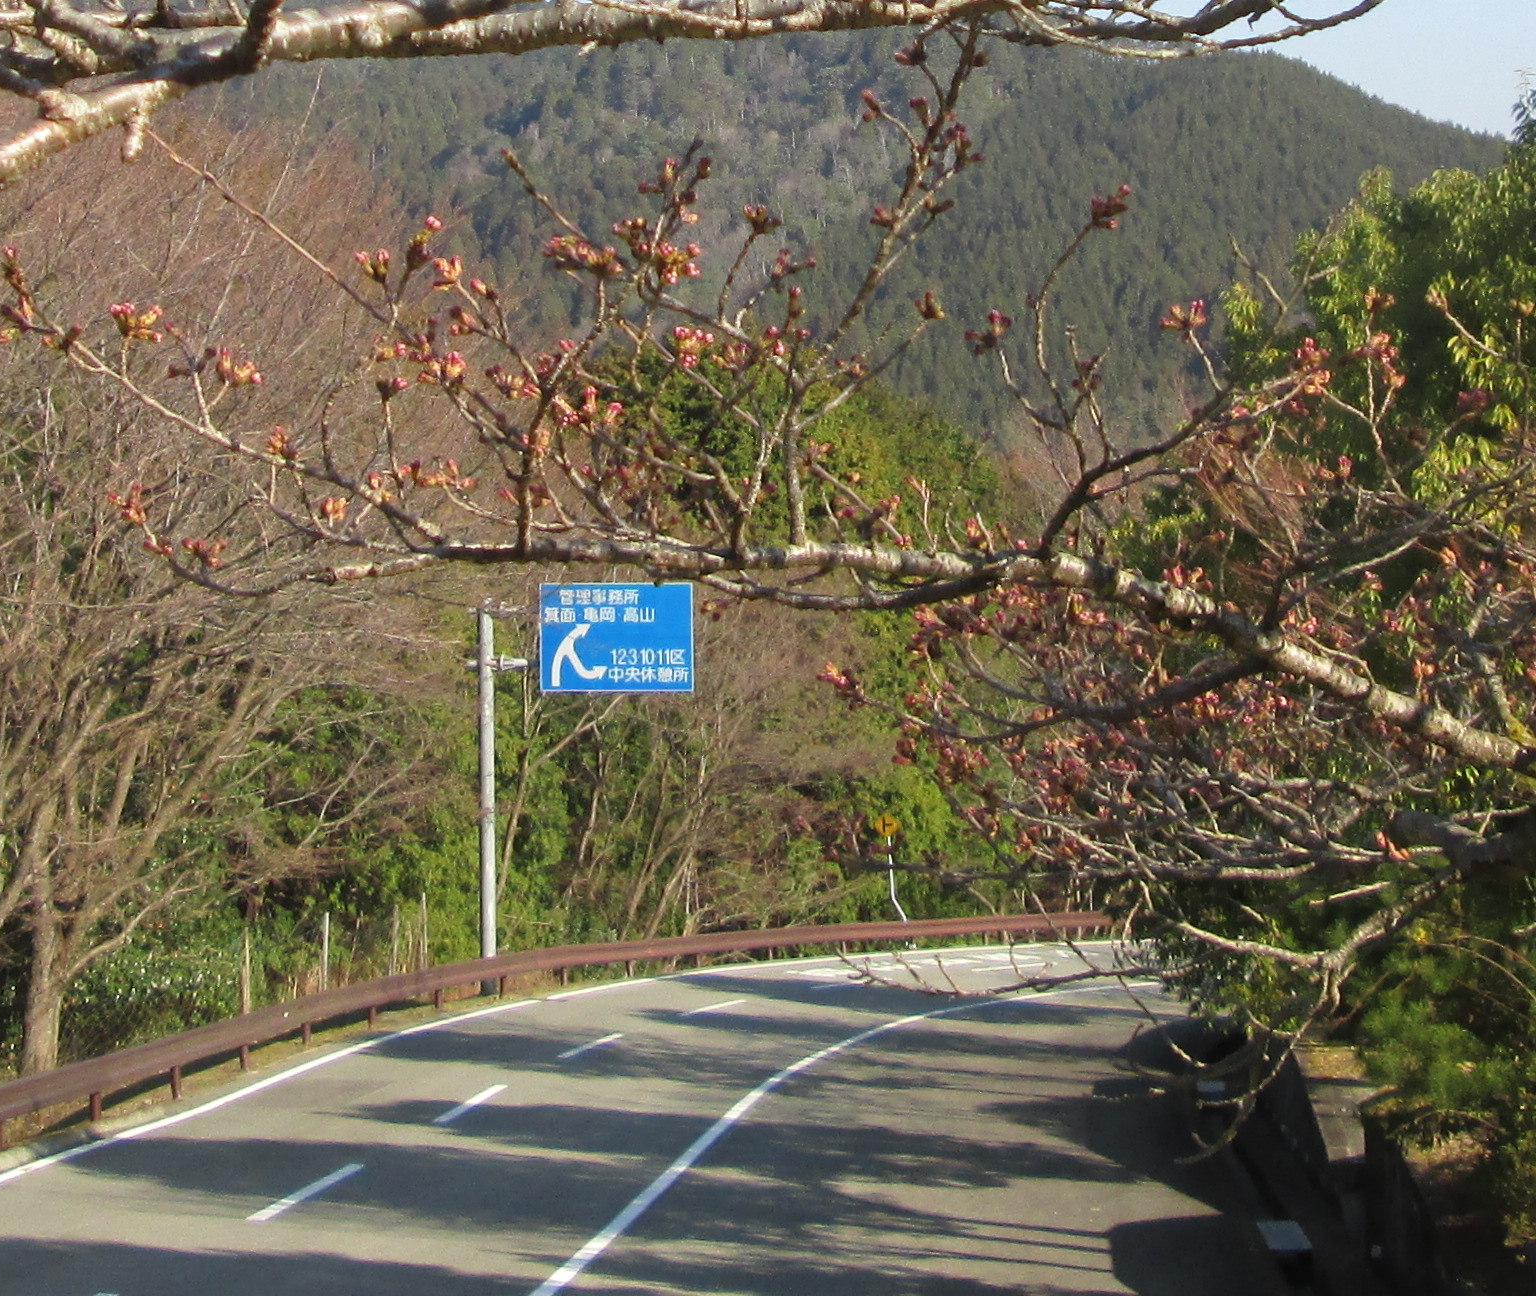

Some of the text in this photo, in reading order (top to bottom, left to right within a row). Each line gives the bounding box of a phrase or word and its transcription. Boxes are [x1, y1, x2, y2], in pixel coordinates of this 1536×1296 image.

[559, 589, 639, 605] 管理事務所
[608, 667, 689, 683] 中央休憩所
